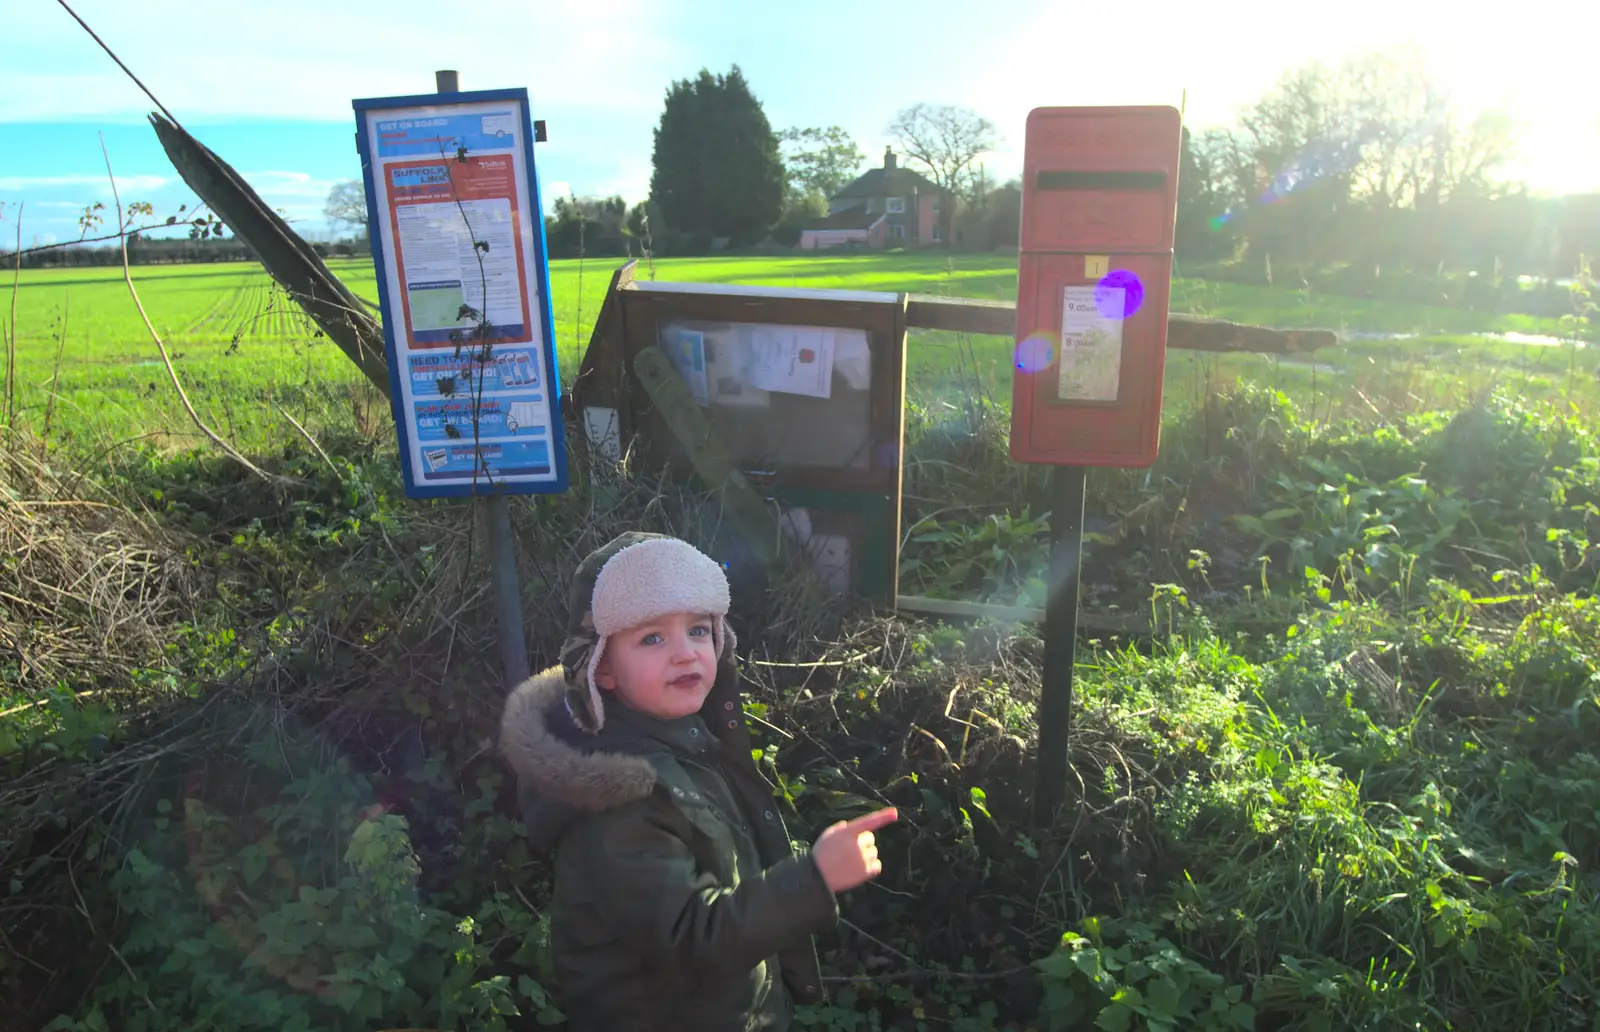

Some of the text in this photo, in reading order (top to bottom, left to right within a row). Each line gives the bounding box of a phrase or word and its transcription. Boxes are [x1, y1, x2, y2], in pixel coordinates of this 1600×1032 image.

[380, 119, 449, 131] GET ON BOARD!
[394, 166, 445, 178] SUFFOLK
[420, 176, 446, 184] LINK
[411, 356, 440, 366] NEED
[413, 371, 433, 381] GET
[436, 370, 453, 379] ON
[419, 417, 440, 427] GET
